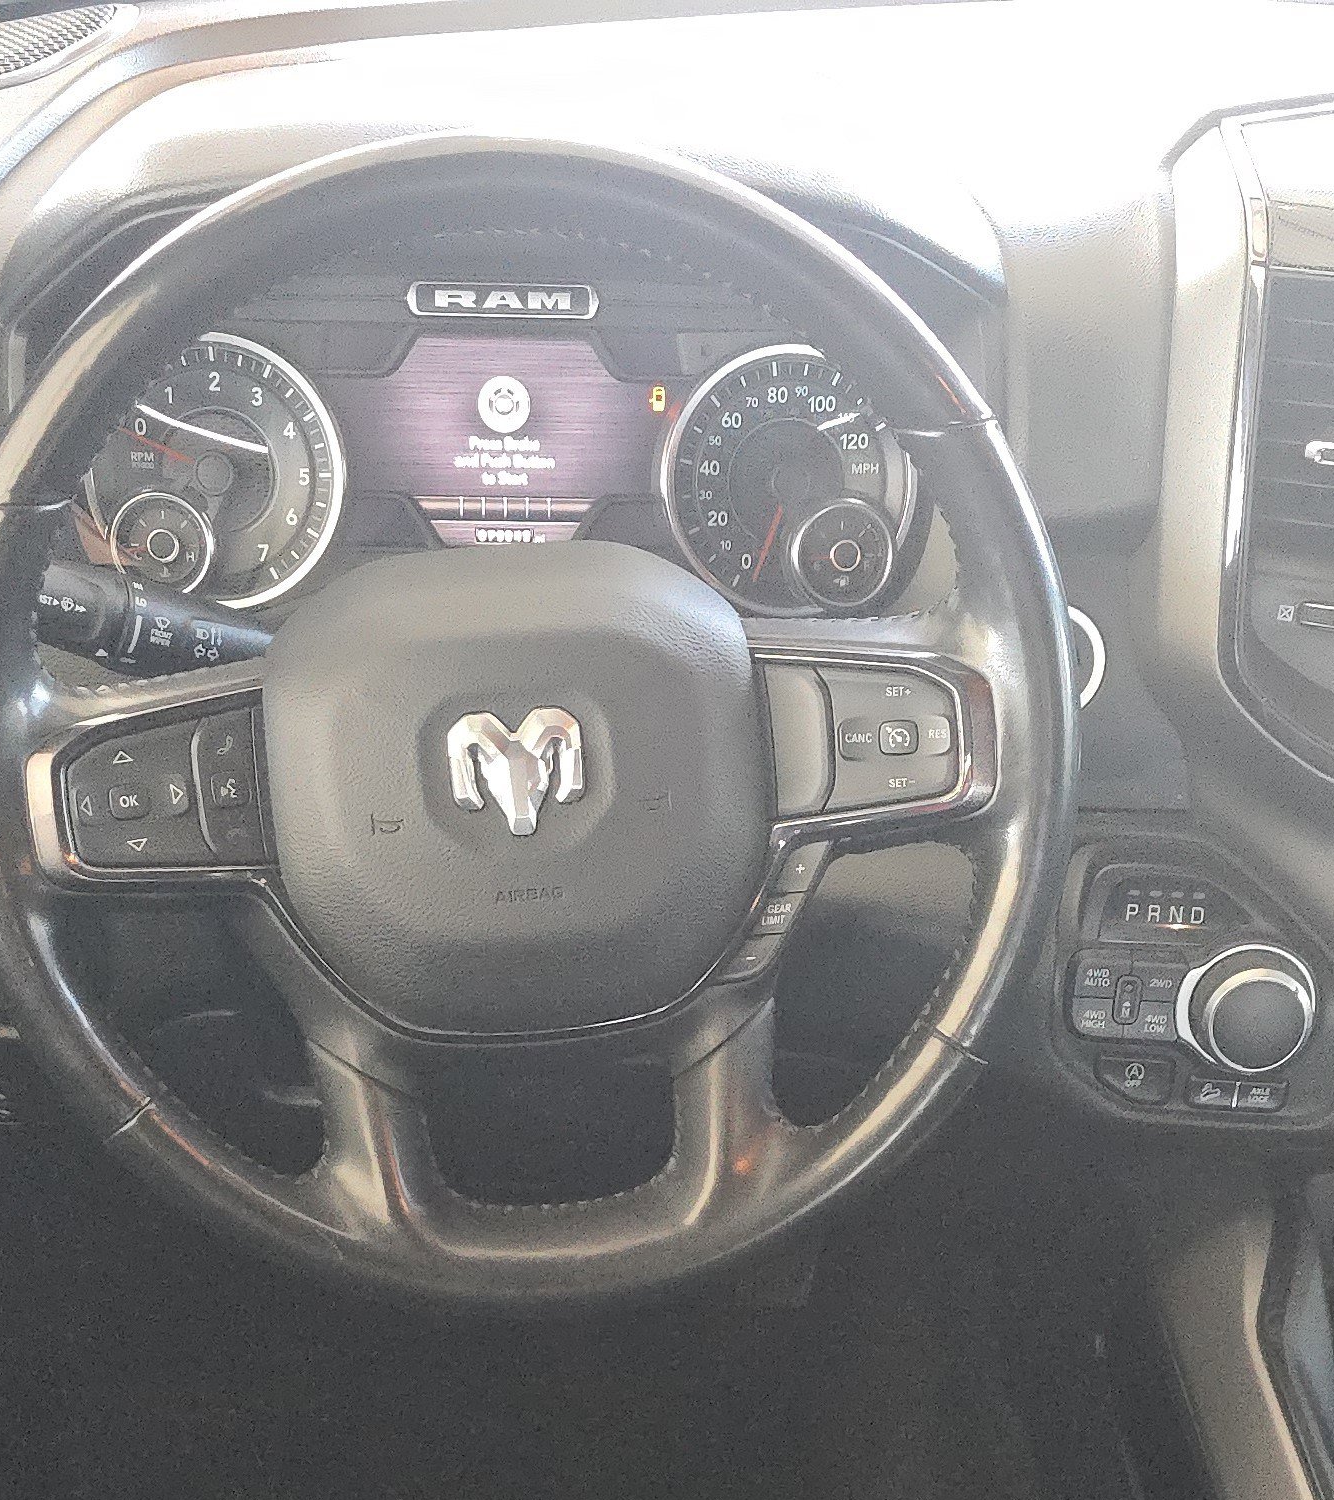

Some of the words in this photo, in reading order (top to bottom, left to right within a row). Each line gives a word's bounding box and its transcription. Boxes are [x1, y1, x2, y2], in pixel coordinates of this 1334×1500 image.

[434, 289, 573, 311] RAM
[208, 371, 221, 392] 2
[164, 386, 174, 404] 1
[251, 387, 264, 407] 3
[767, 386, 788, 404] 80
[795, 385, 809, 397] 90
[746, 396, 759, 408] 70
[807, 395, 836, 413] 100
[721, 411, 742, 429] 60
[134, 418, 147, 436] 0
[283, 421, 297, 440] 4
[708, 435, 722, 446] 50
[839, 433, 869, 450] 120
[130, 451, 155, 461] RPM
[699, 460, 720, 476] 40
[851, 463, 880, 475] MPH
[298, 467, 310, 486] 5
[698, 490, 713, 501] 30
[285, 508, 298, 526] 6
[707, 510, 728, 527] 20
[720, 540, 732, 551] 10
[258, 543, 270, 562] 7
[741, 553, 752, 570] 0
[845, 732, 873, 743] CANC
[928, 729, 948, 739] RES
[119, 794, 139, 808] OK
[767, 903, 792, 914] GEAR
[1125, 903, 1139, 922] P
[1147, 904, 1161, 923] R
[1168, 905, 1184, 923] N
[1190, 907, 1205, 924] D
[761, 915, 787, 926] LIMIT
[1087, 968, 1110, 978] 4WD
[1084, 977, 1110, 987] AUTO
[1149, 978, 1172, 989] 2WD
[1083, 1009, 1106, 1019] 4WD
[1145, 1014, 1167, 1025] 4WD
[1081, 1018, 1105, 1029] HIGH
[1144, 1023, 1166, 1034] LOW
